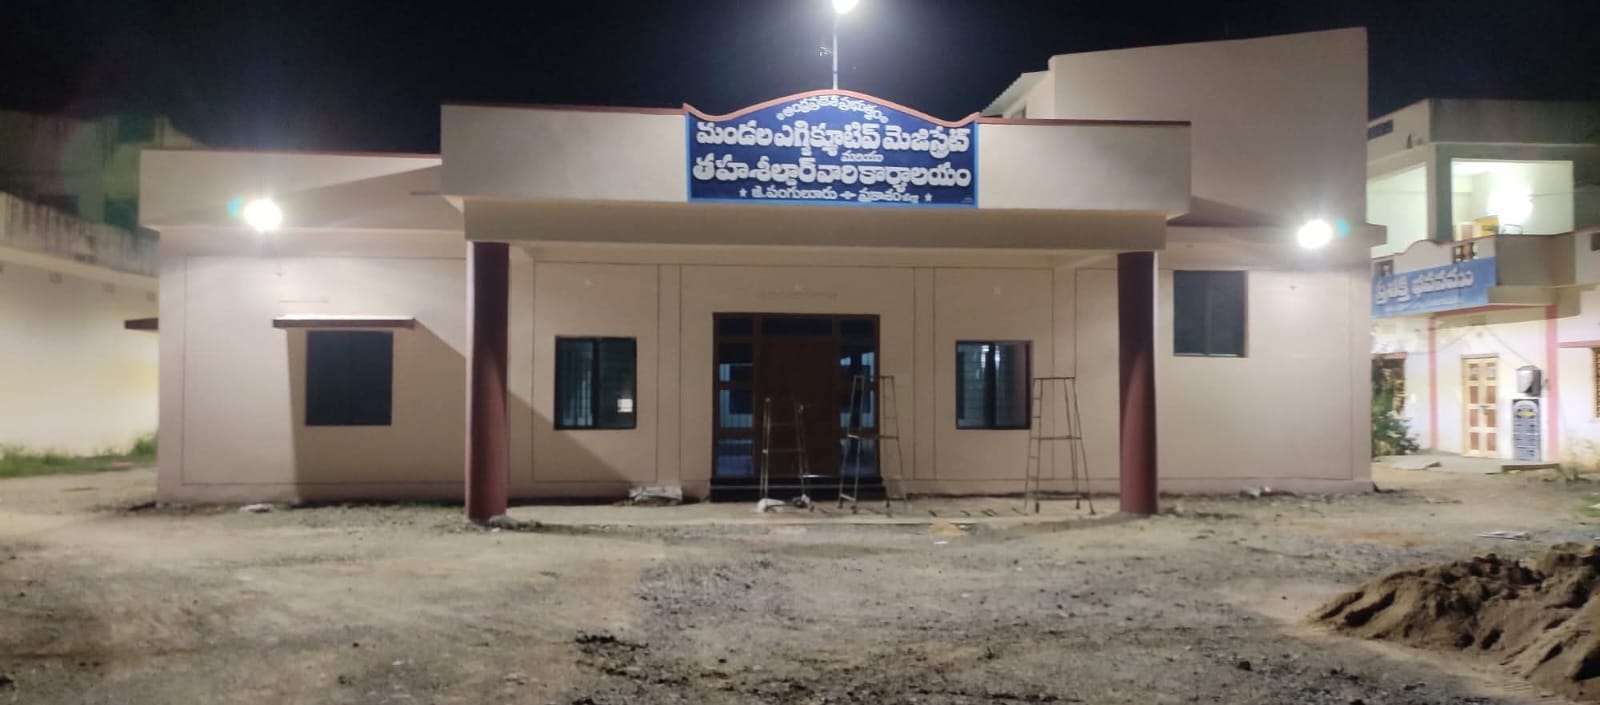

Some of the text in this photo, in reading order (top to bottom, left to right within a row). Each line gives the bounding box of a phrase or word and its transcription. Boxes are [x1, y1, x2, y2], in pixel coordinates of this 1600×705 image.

[696, 120, 773, 145] మండల
[840, 150, 884, 162] మరియు
[817, 164, 858, 185] వారి
[859, 162, 971, 191] కార్యాలయం
